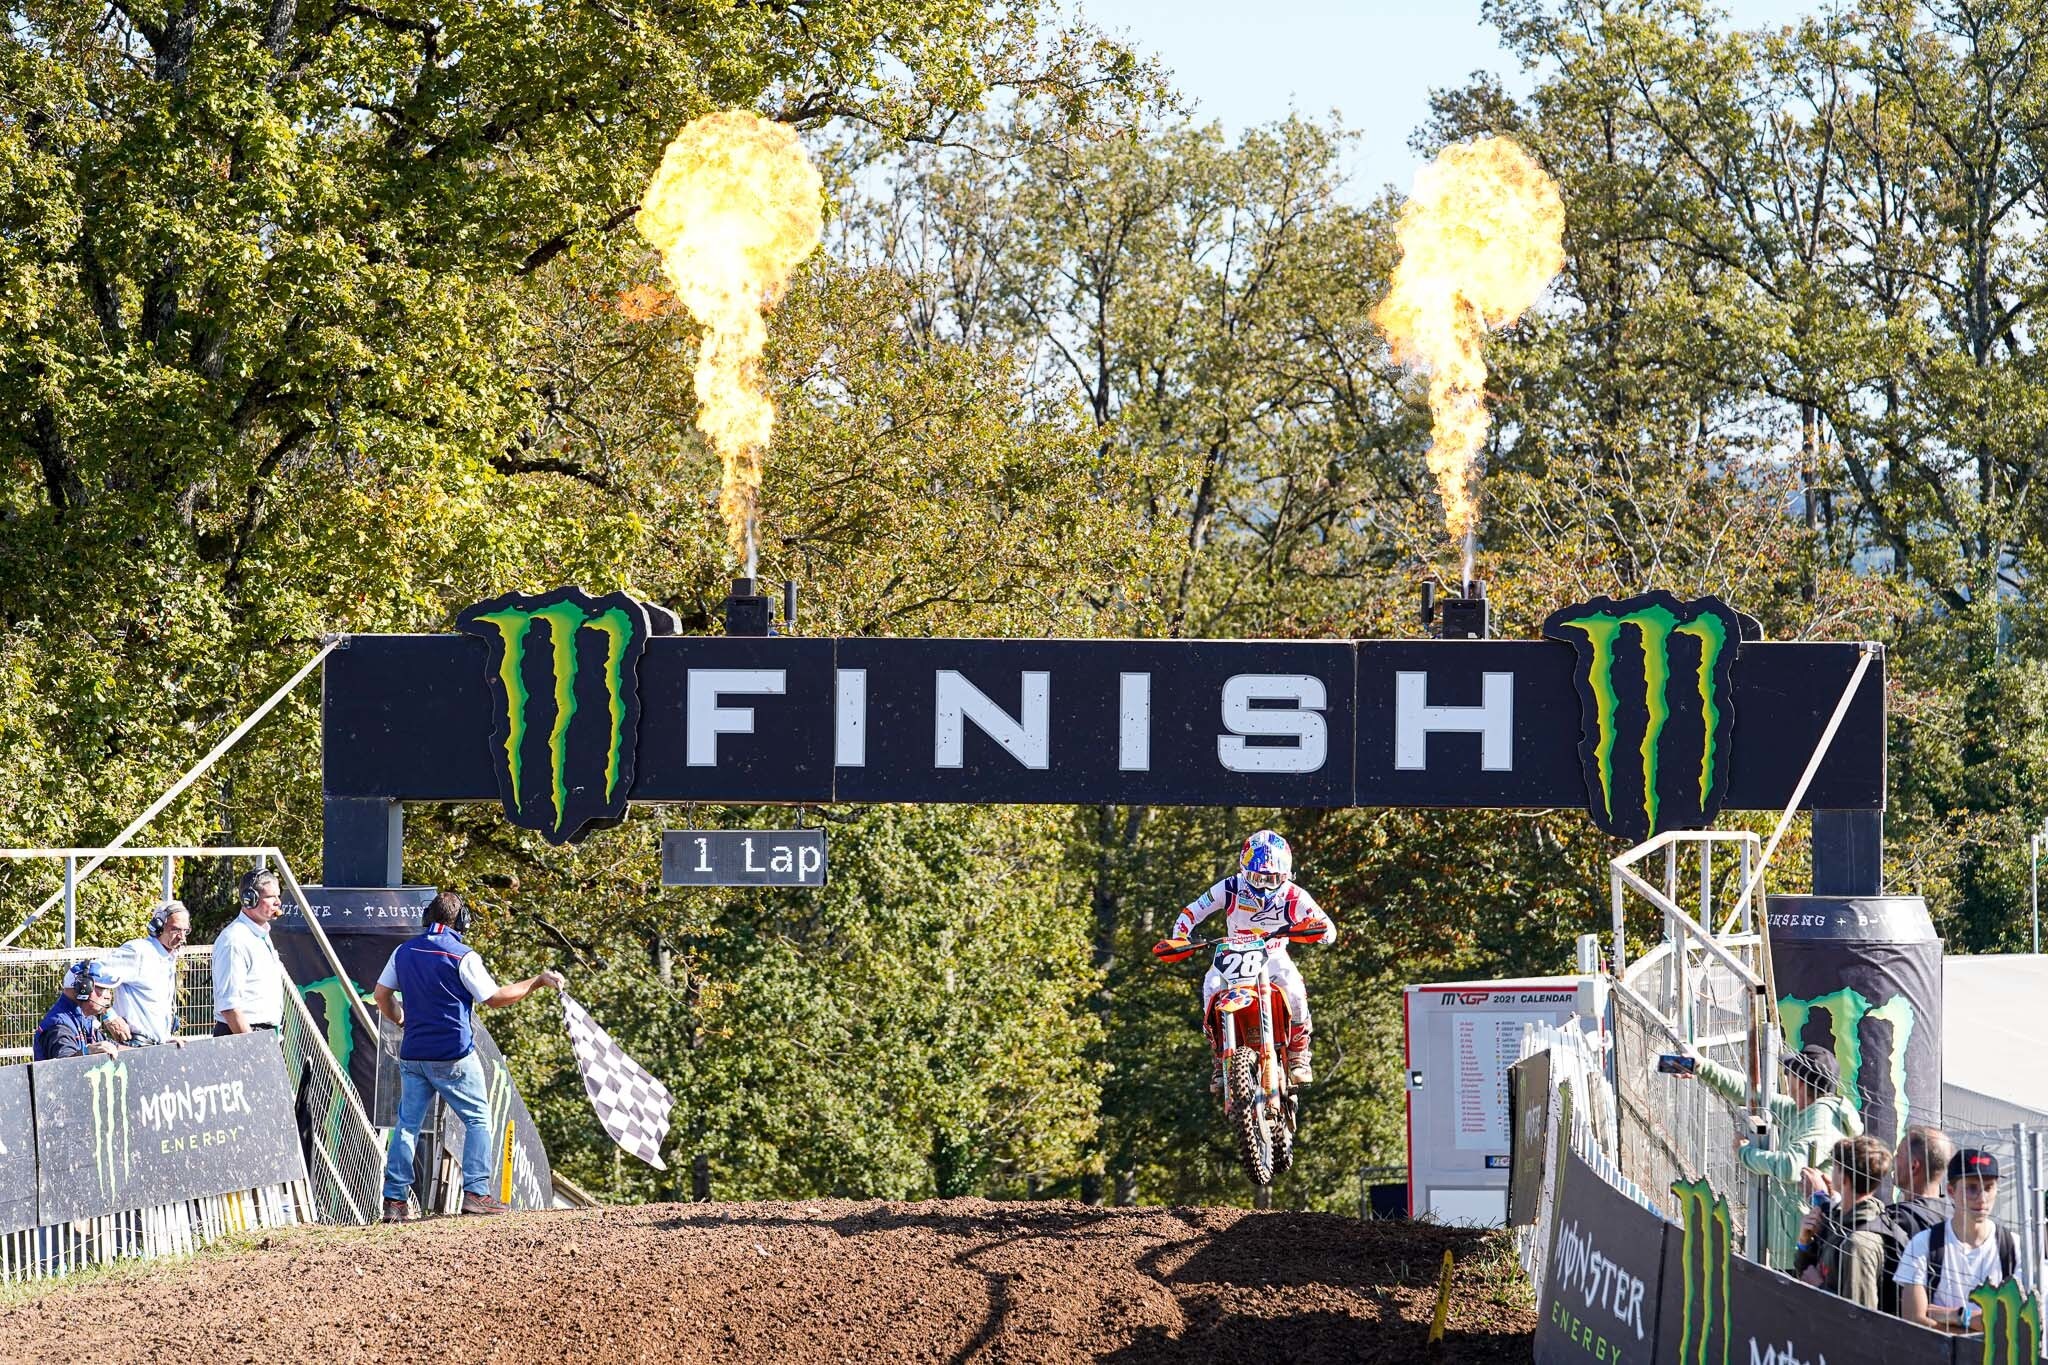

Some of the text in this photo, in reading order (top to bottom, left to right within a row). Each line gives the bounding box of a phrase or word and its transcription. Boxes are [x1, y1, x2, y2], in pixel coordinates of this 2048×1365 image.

[687, 669, 1513, 774] FINISH
[694, 837, 822, 882] 1 Lap
[364, 902, 425, 919] TAURIN
[1222, 950, 1263, 979] 28
[1441, 992, 1573, 1006] MXGP 2021 CALENDAR
[161, 1127, 240, 1154] ENERGY
[1551, 1300, 1622, 1365] ENERGY
